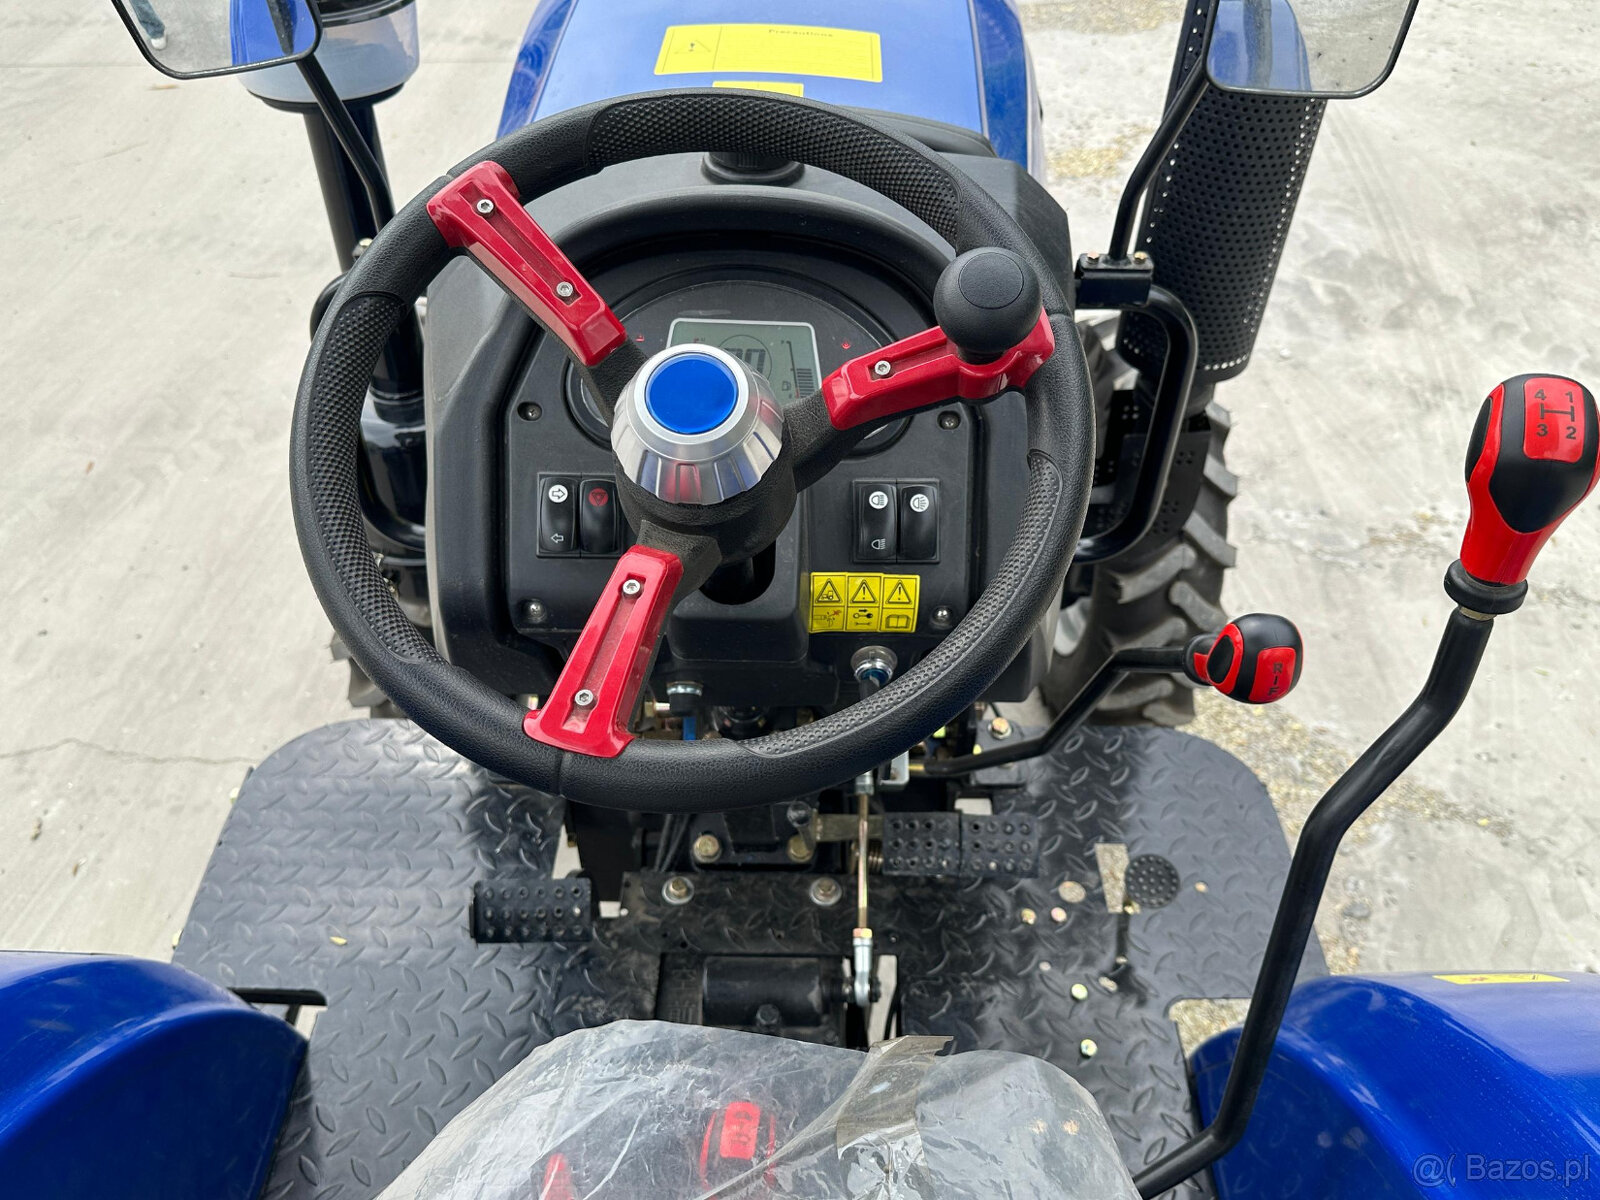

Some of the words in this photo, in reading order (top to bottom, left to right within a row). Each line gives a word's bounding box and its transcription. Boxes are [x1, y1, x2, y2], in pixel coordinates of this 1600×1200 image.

[1535, 389, 1546, 400] 4
[1565, 391, 1574, 403] 1
[1536, 424, 1548, 437] 3
[1566, 426, 1576, 439] 2
